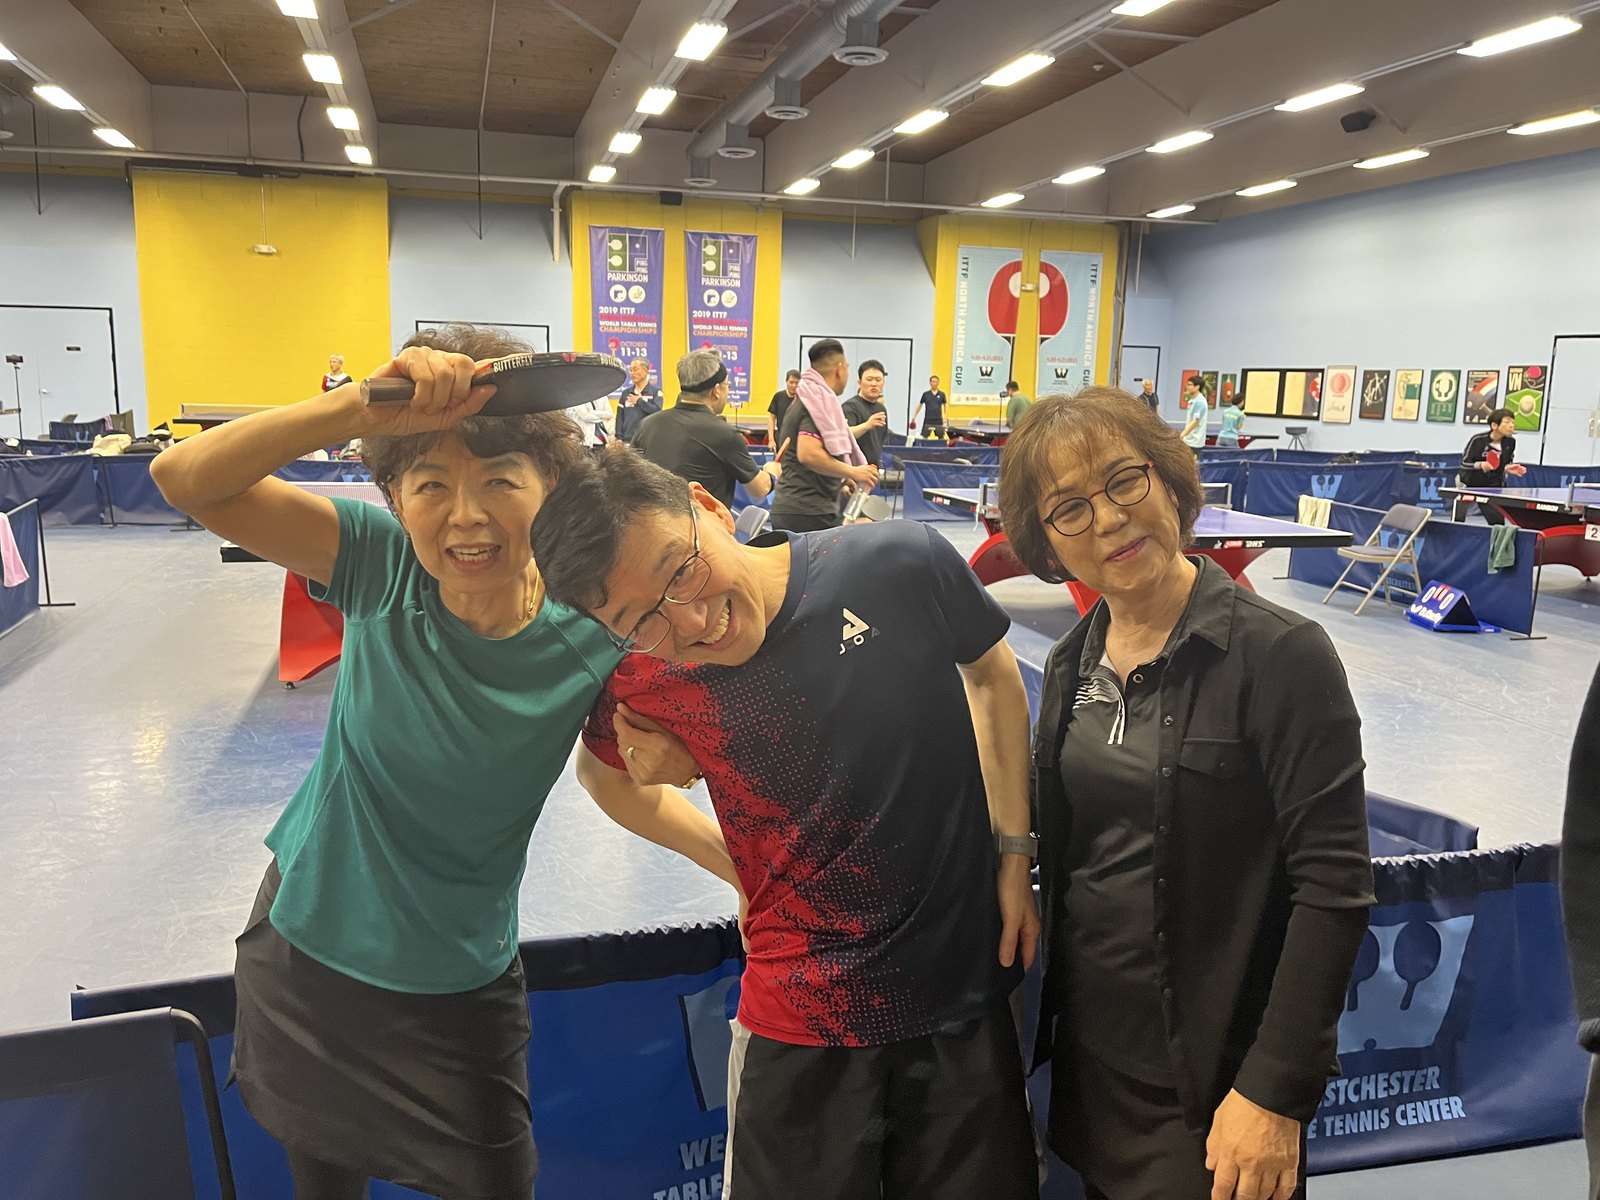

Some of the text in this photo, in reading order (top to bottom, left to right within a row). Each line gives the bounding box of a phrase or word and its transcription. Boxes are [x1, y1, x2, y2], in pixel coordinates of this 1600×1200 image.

[608, 272, 648, 283] PARKINSON
[1090, 264, 1098, 284] ITTF
[702, 278, 740, 288] PARKINSON
[600, 326, 657, 334] CHAMPIONSHIPS
[693, 330, 748, 338] CHAMPIONSHIPS
[956, 318, 966, 363] AMERICA
[620, 346, 648, 357] 11-13
[493, 354, 533, 373] BUTTERFLY
[955, 366, 963, 386] CUP
[1591, 528, 1598, 538] 2
[1319, 1066, 1440, 1108] STCHESTER
[1324, 1108, 1390, 1137] TENNIS
[1395, 1096, 1467, 1126] CENTER
